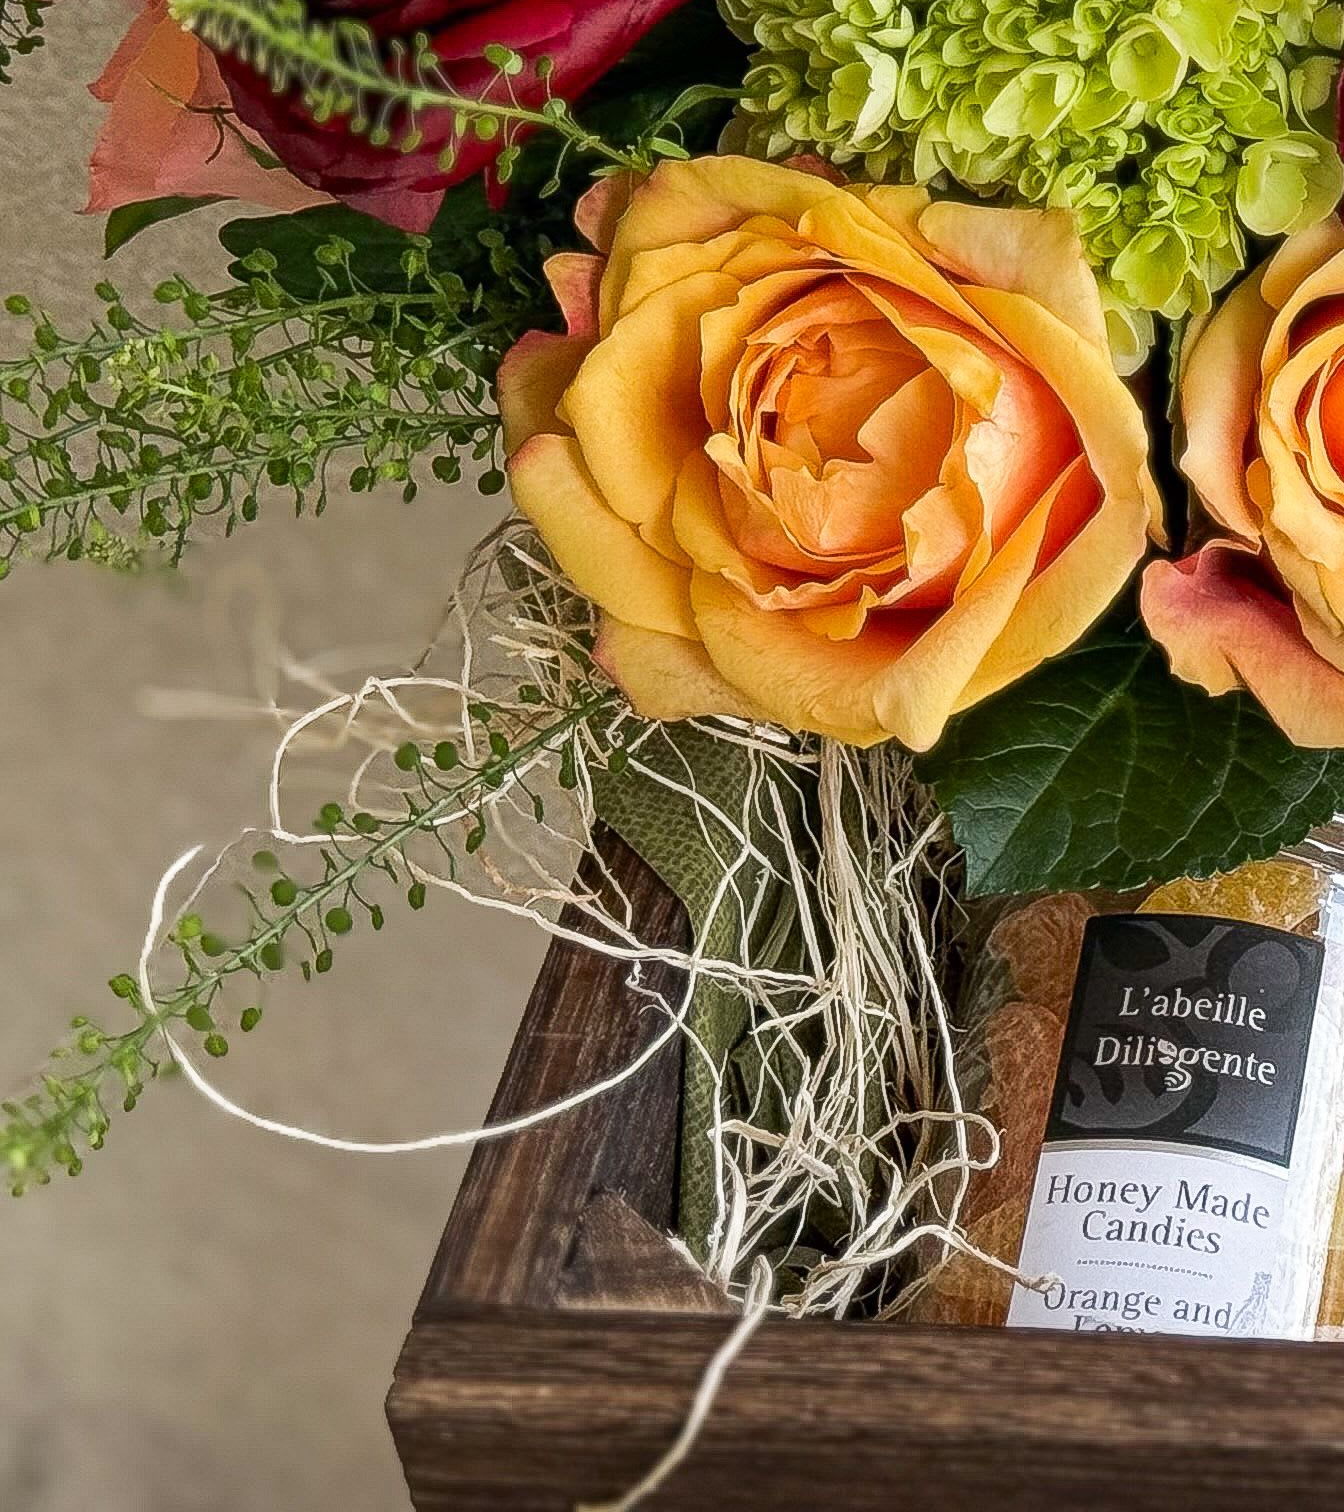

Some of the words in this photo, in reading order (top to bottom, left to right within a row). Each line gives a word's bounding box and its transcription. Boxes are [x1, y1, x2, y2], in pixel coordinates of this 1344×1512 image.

[1118, 986, 1267, 1032] L'abeille
[1093, 1035, 1276, 1092] Diligente
[1046, 1174, 1162, 1214] Honey
[1175, 1179, 1271, 1229] Made
[1082, 1209, 1222, 1255] Candies
[1043, 1282, 1162, 1320] Orange
[1173, 1299, 1233, 1330] and
